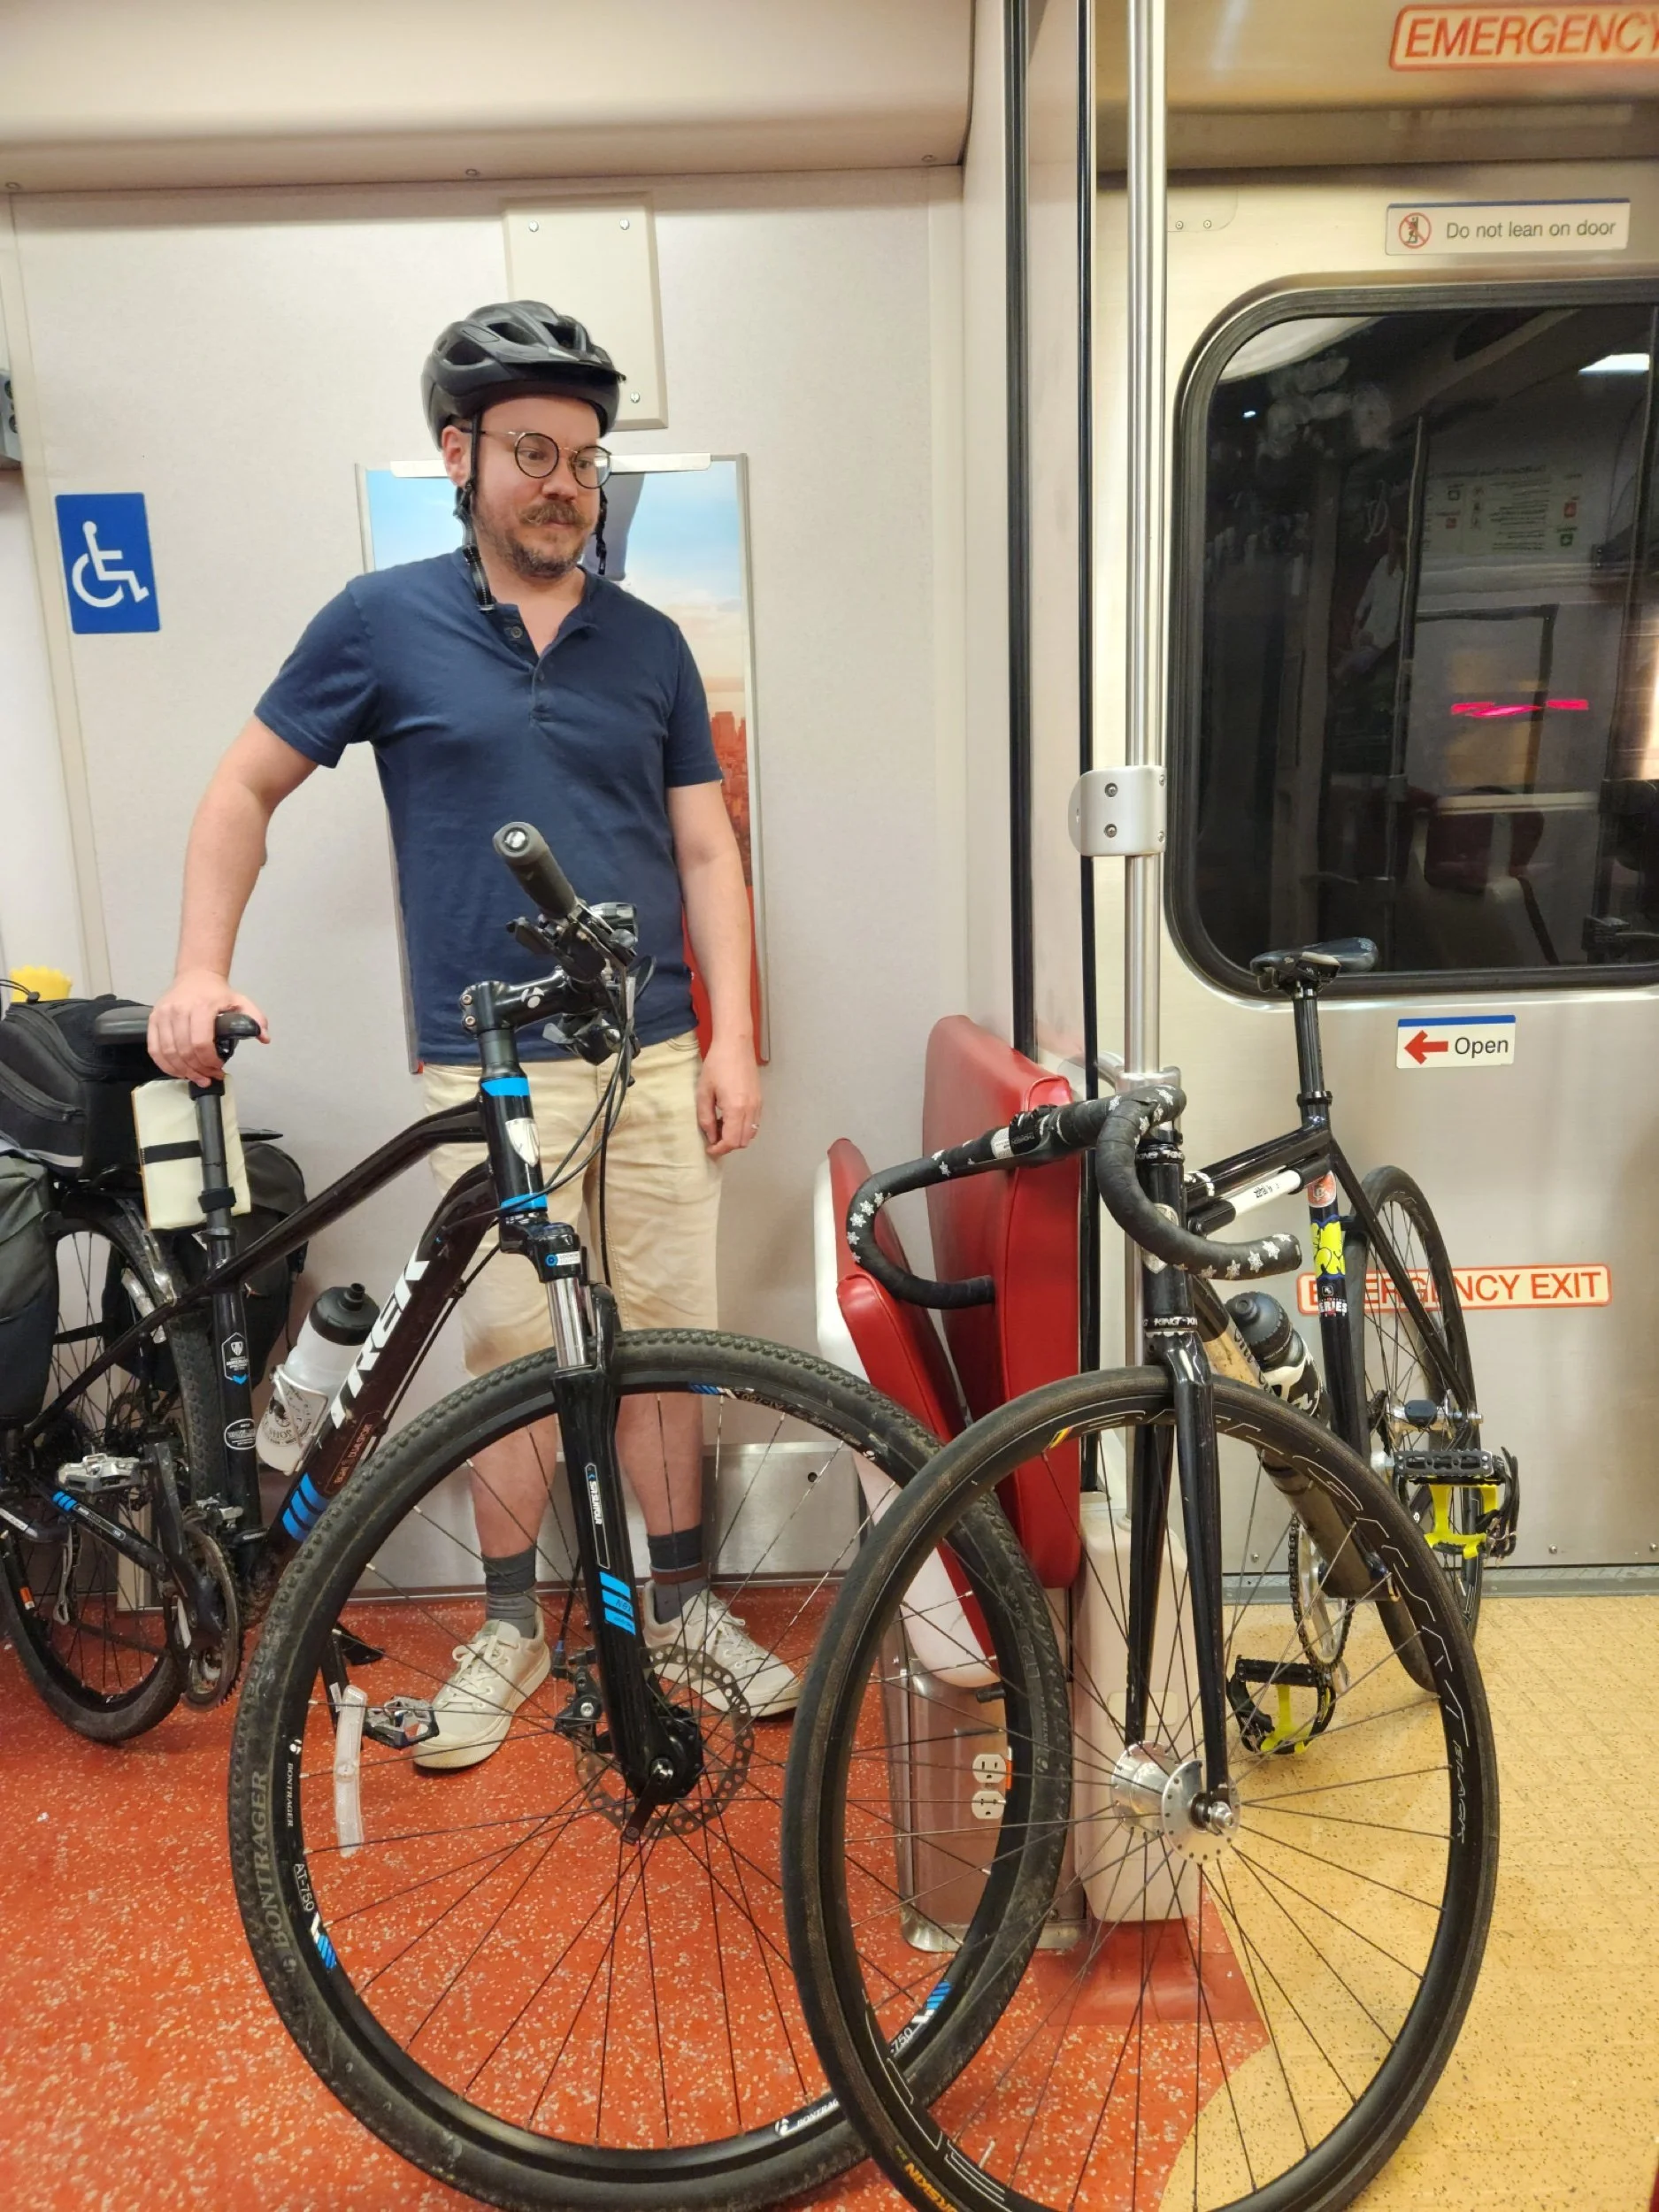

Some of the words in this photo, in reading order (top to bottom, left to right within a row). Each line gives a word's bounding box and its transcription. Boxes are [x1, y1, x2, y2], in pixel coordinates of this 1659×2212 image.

[1447, 222, 1470, 239] Do
[1476, 222, 1502, 238] not
[1509, 221, 1543, 237] lean
[1548, 222, 1571, 237] on
[1577, 219, 1617, 236] door
[1455, 1036, 1509, 1059] Open
[1530, 1271, 1601, 1301] EXIT
[286, 1762, 295, 1828] BONTRAGER
[250, 1770, 289, 1950] BONTRAGER
[293, 1863, 315, 1912] AT-750
